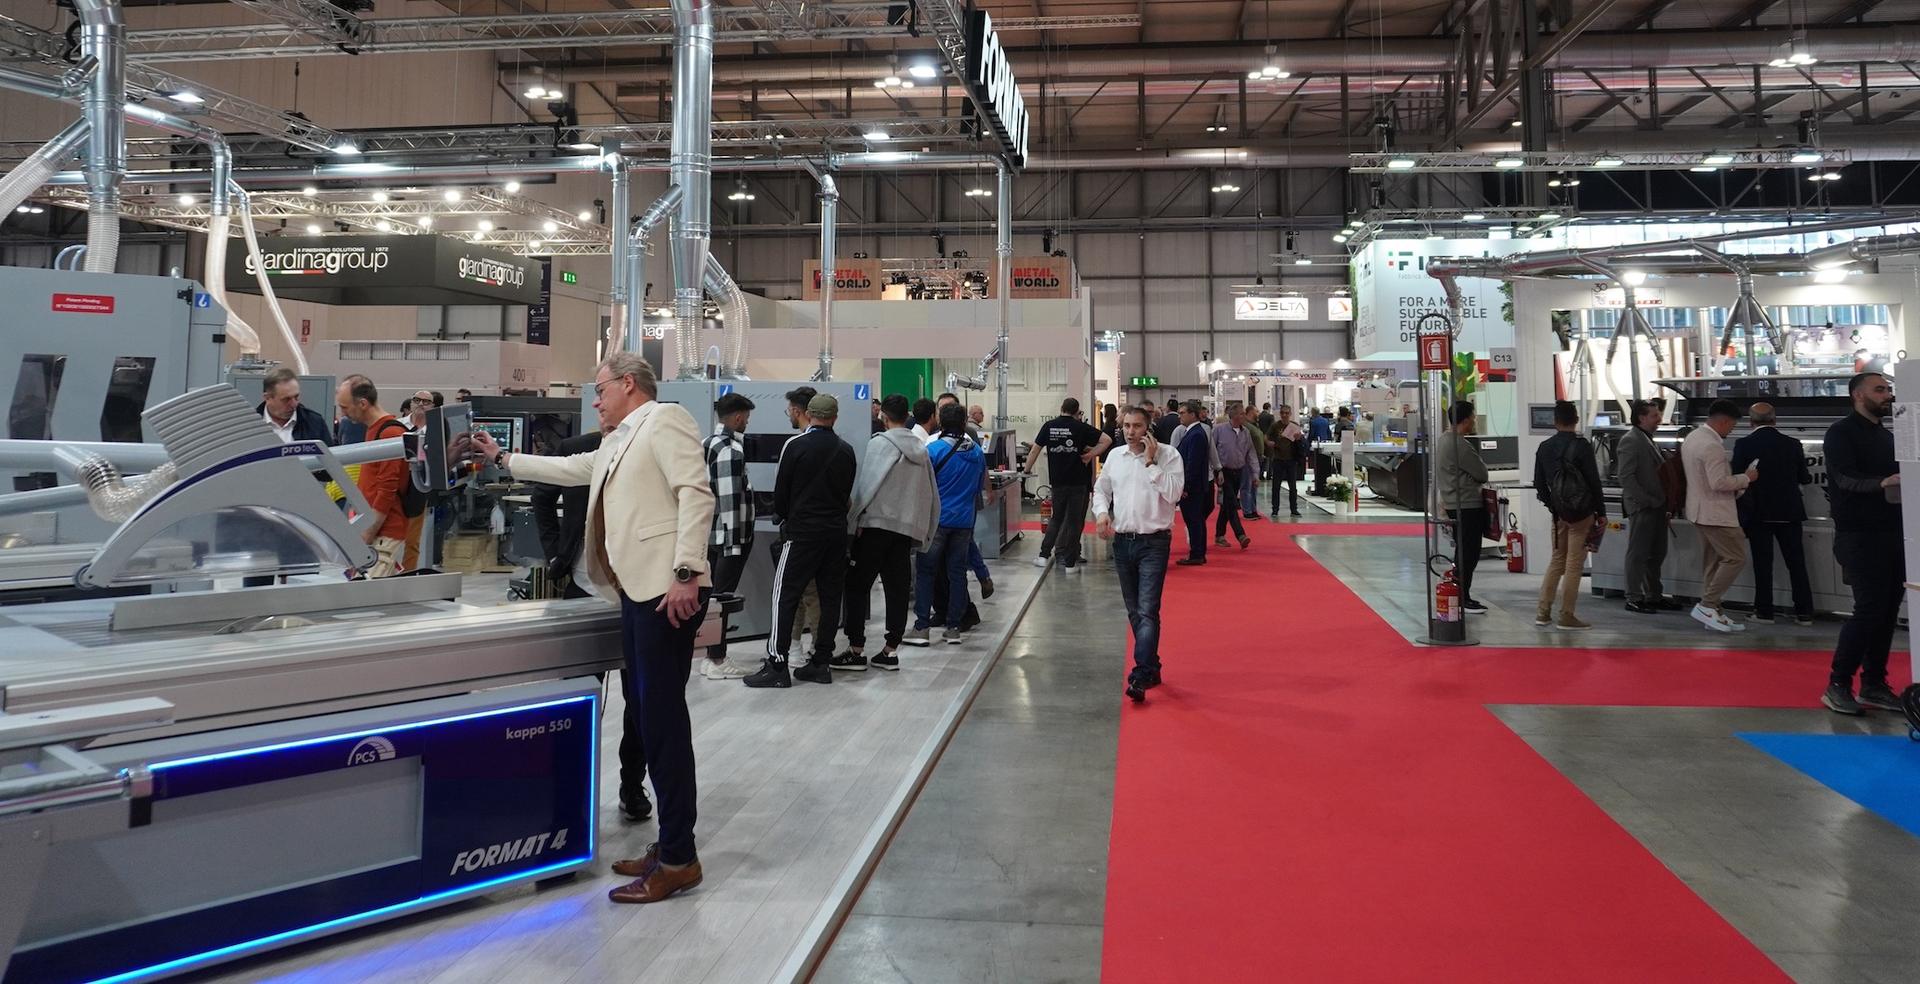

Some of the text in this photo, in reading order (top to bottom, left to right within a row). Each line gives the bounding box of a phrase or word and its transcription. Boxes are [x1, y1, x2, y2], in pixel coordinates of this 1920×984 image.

[459, 254, 524, 289] giardinagroup
[834, 269, 867, 279] ETAL
[834, 279, 871, 289] ORLD
[1014, 278, 1060, 288] WORLD
[1257, 301, 1306, 311] DELTA
[1399, 296, 1476, 307] FOR A MRE
[1399, 308, 1488, 319] SUSTAINBLE
[1493, 354, 1512, 363] C13
[505, 718, 572, 741] kappa 550
[355, 750, 376, 765] PCS
[450, 828, 569, 876] FORMAT 4
